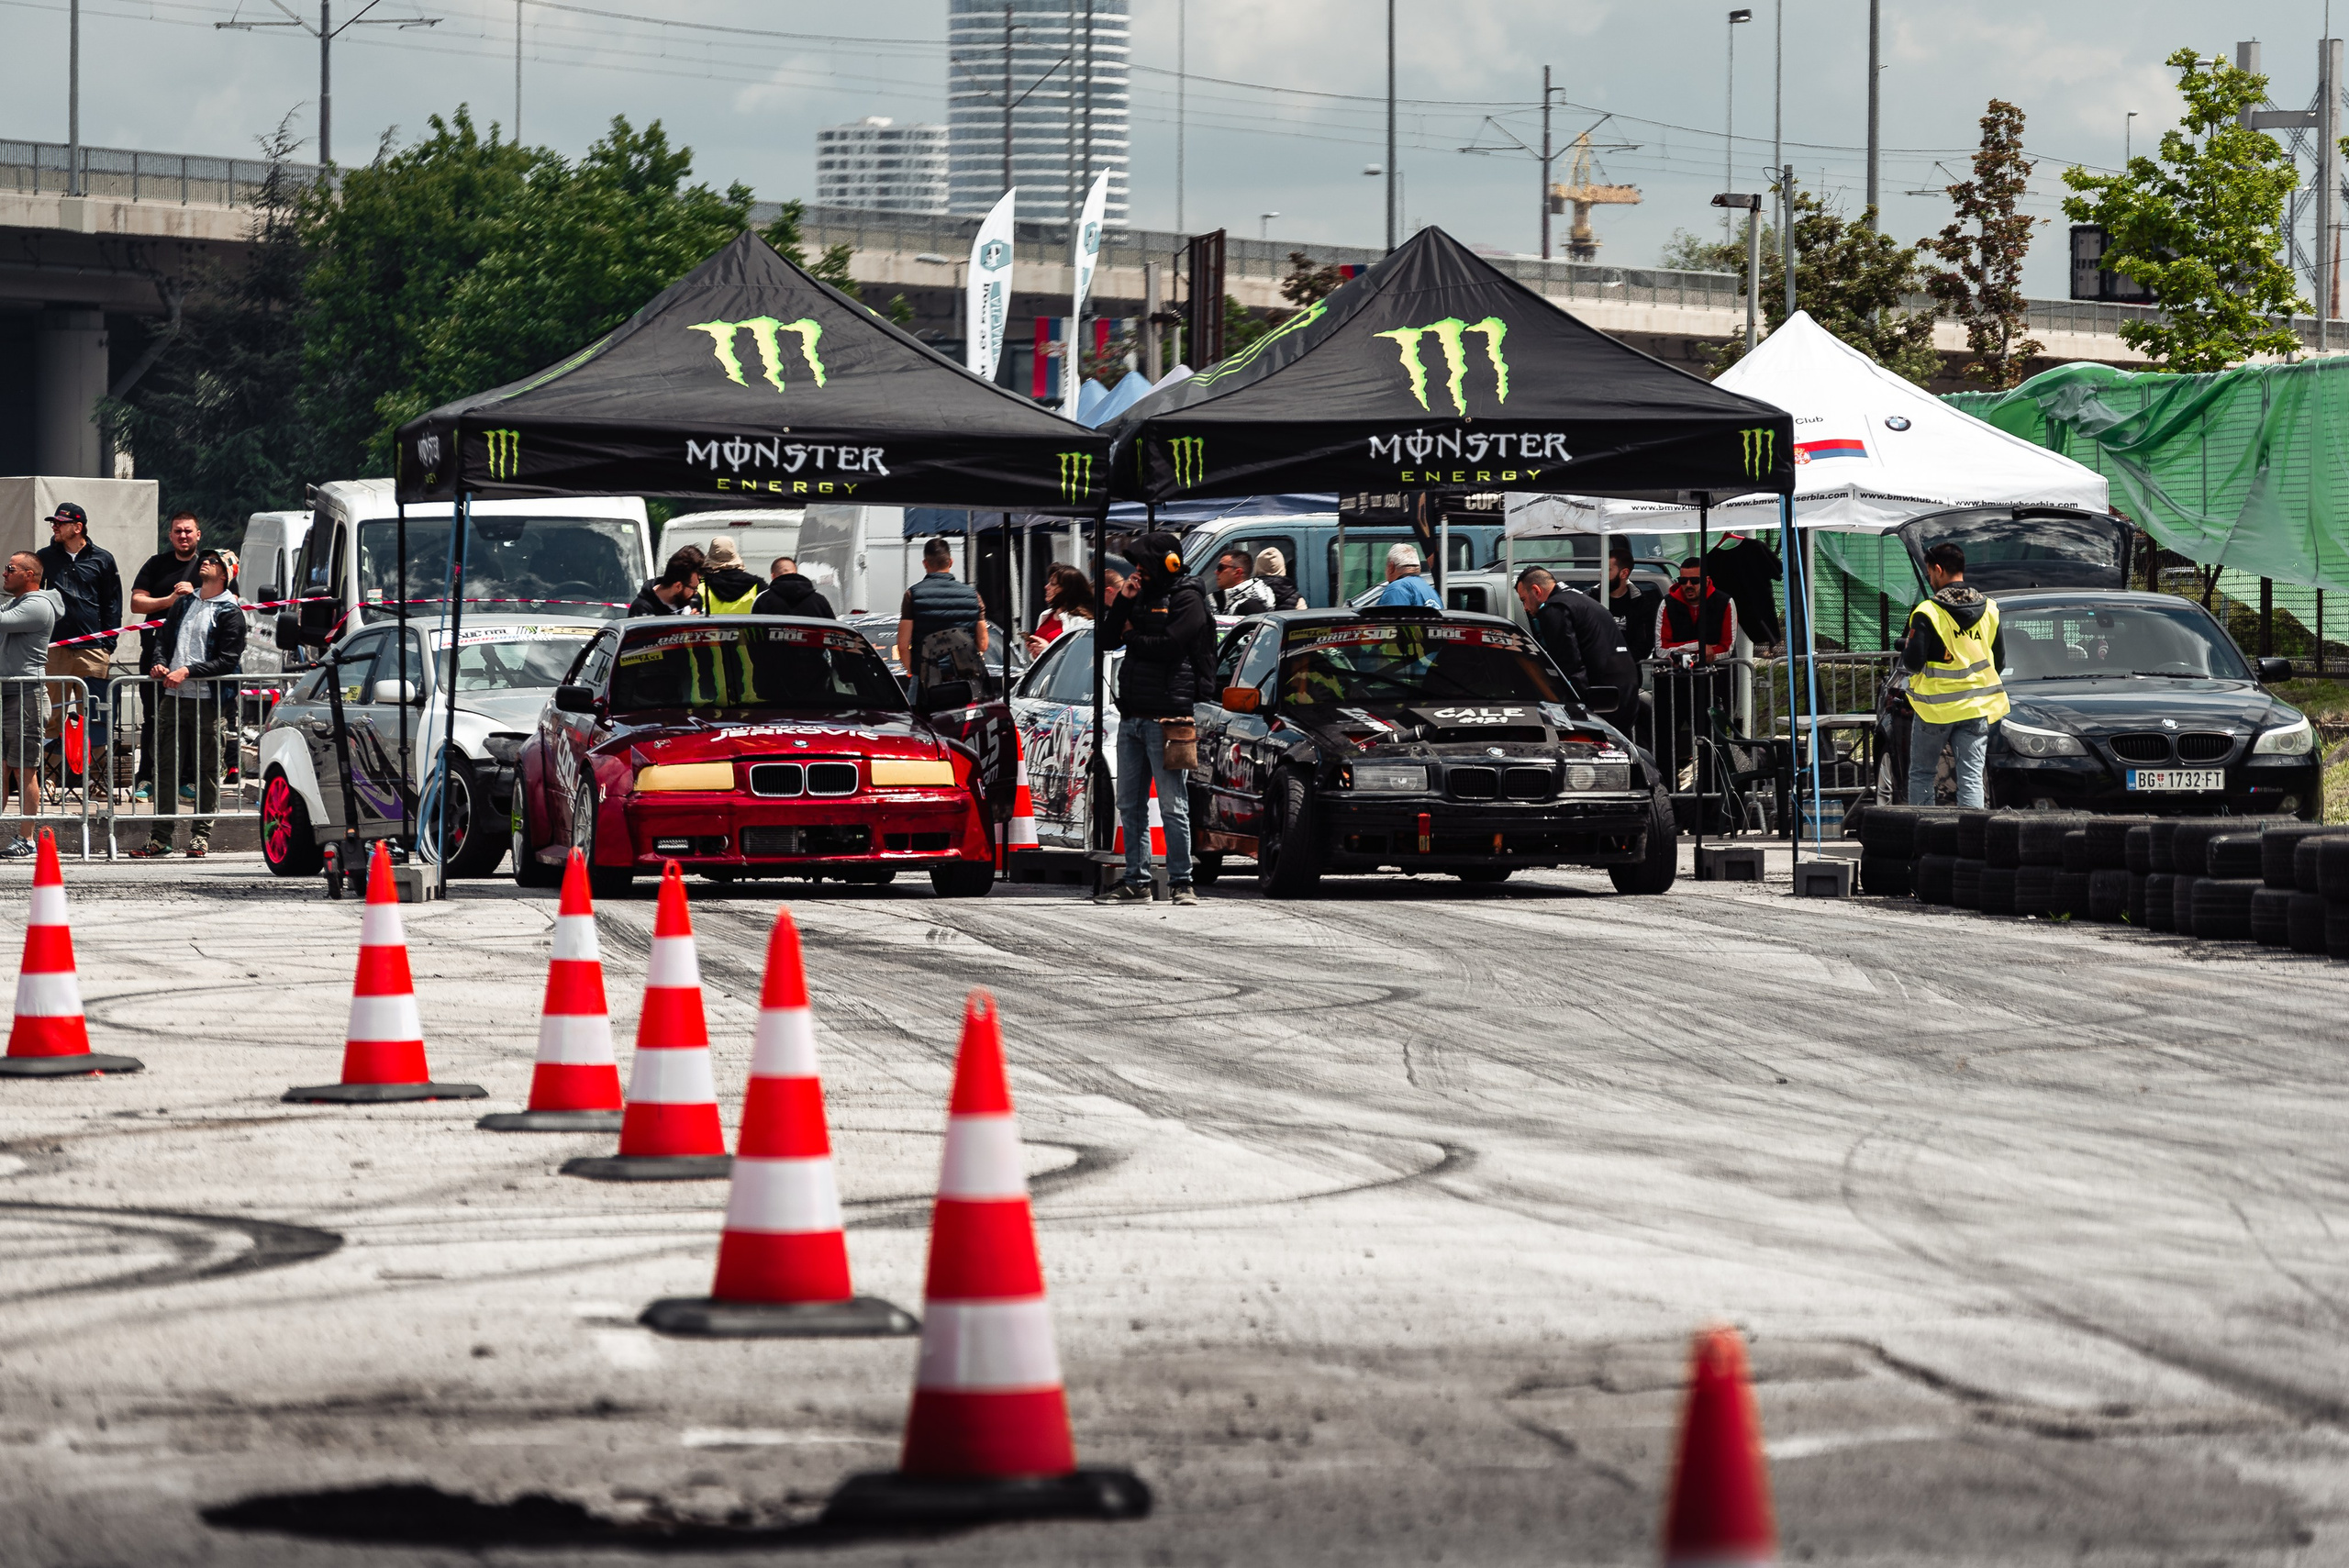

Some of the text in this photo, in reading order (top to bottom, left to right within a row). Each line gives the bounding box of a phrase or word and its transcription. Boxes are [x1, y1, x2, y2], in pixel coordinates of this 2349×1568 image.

[1795, 416, 1824, 425] Club
[1368, 428, 1573, 464] MONSTER
[685, 436, 890, 476] MONSTER
[1401, 469, 1542, 483] ENERGY
[717, 478, 858, 495] ENERGY
[703, 630, 740, 641] SDC
[1362, 628, 1397, 639] SDC
[1433, 706, 1525, 718] CALE
[2139, 773, 2155, 787] BG
